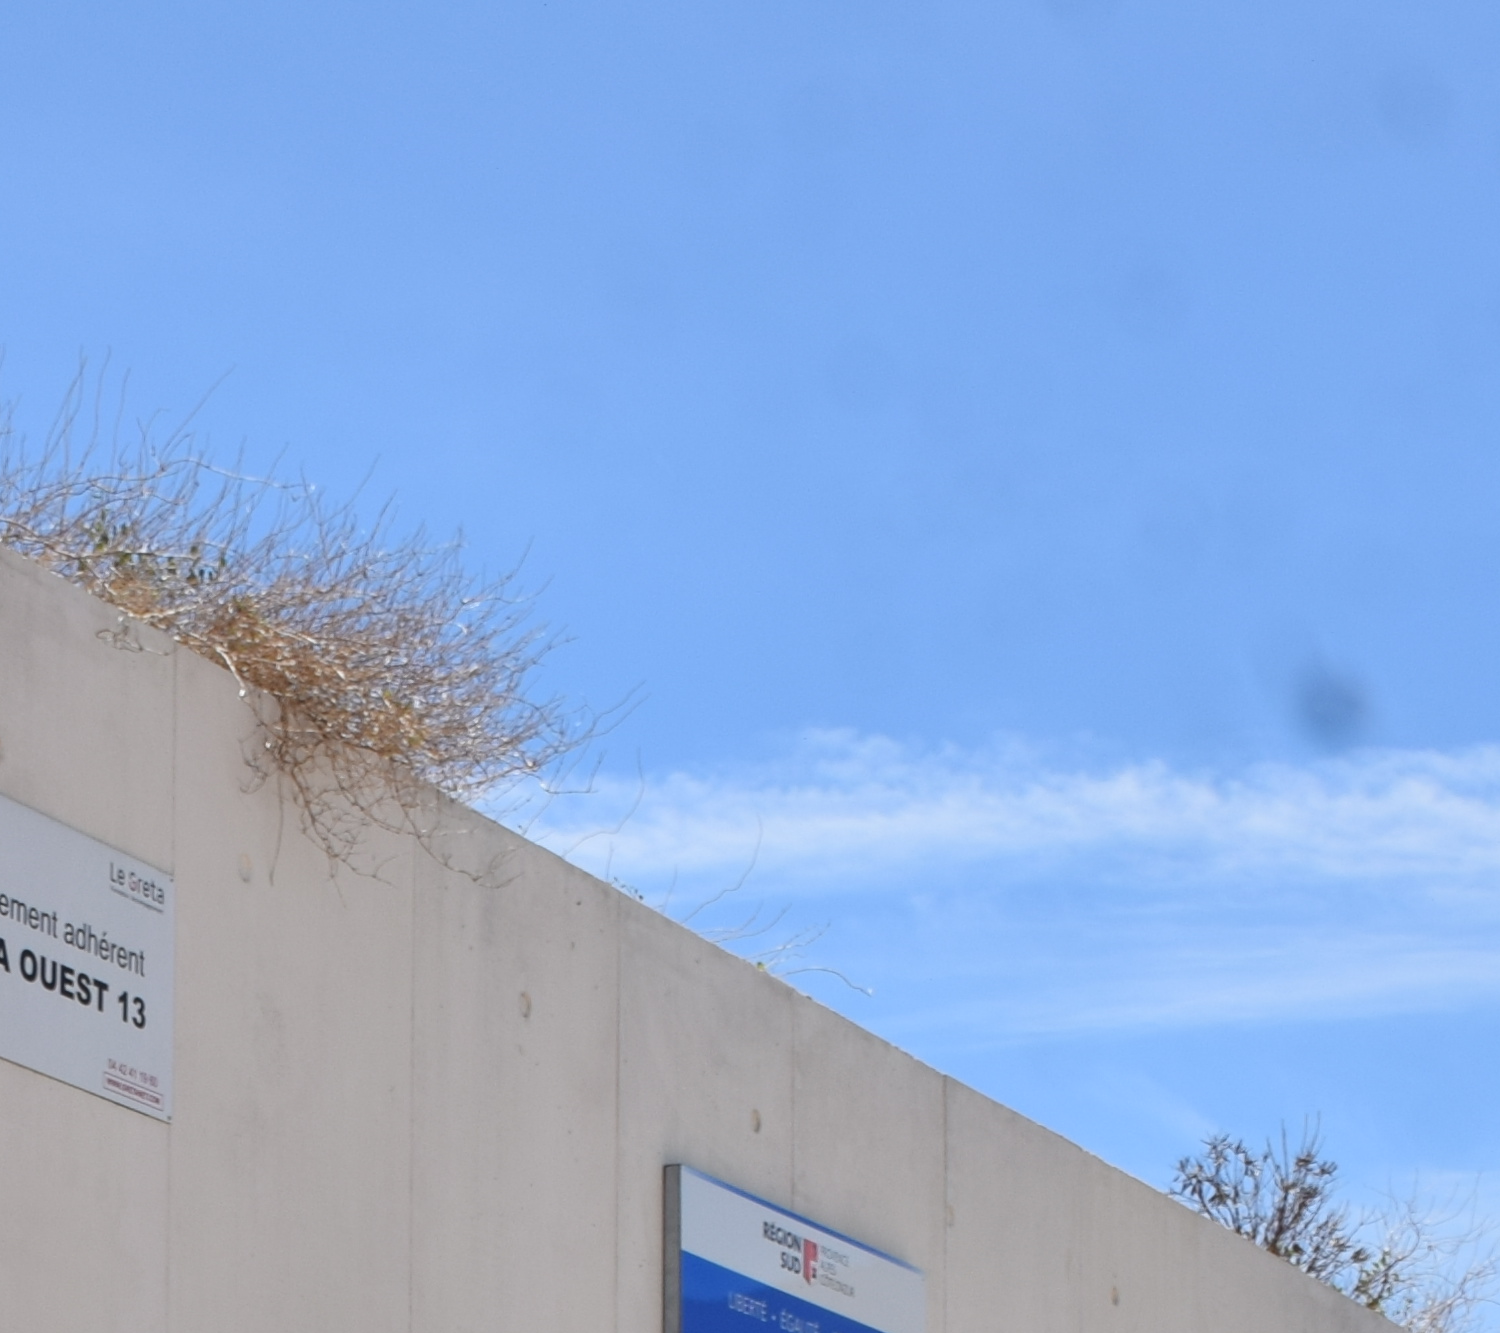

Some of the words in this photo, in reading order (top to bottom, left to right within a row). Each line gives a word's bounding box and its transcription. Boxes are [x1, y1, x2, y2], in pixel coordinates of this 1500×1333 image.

[63, 922, 146, 977] adhérent
[19, 949, 109, 1012] OUEST
[118, 991, 147, 1030] 13
[780, 1251, 801, 1275] SUD
